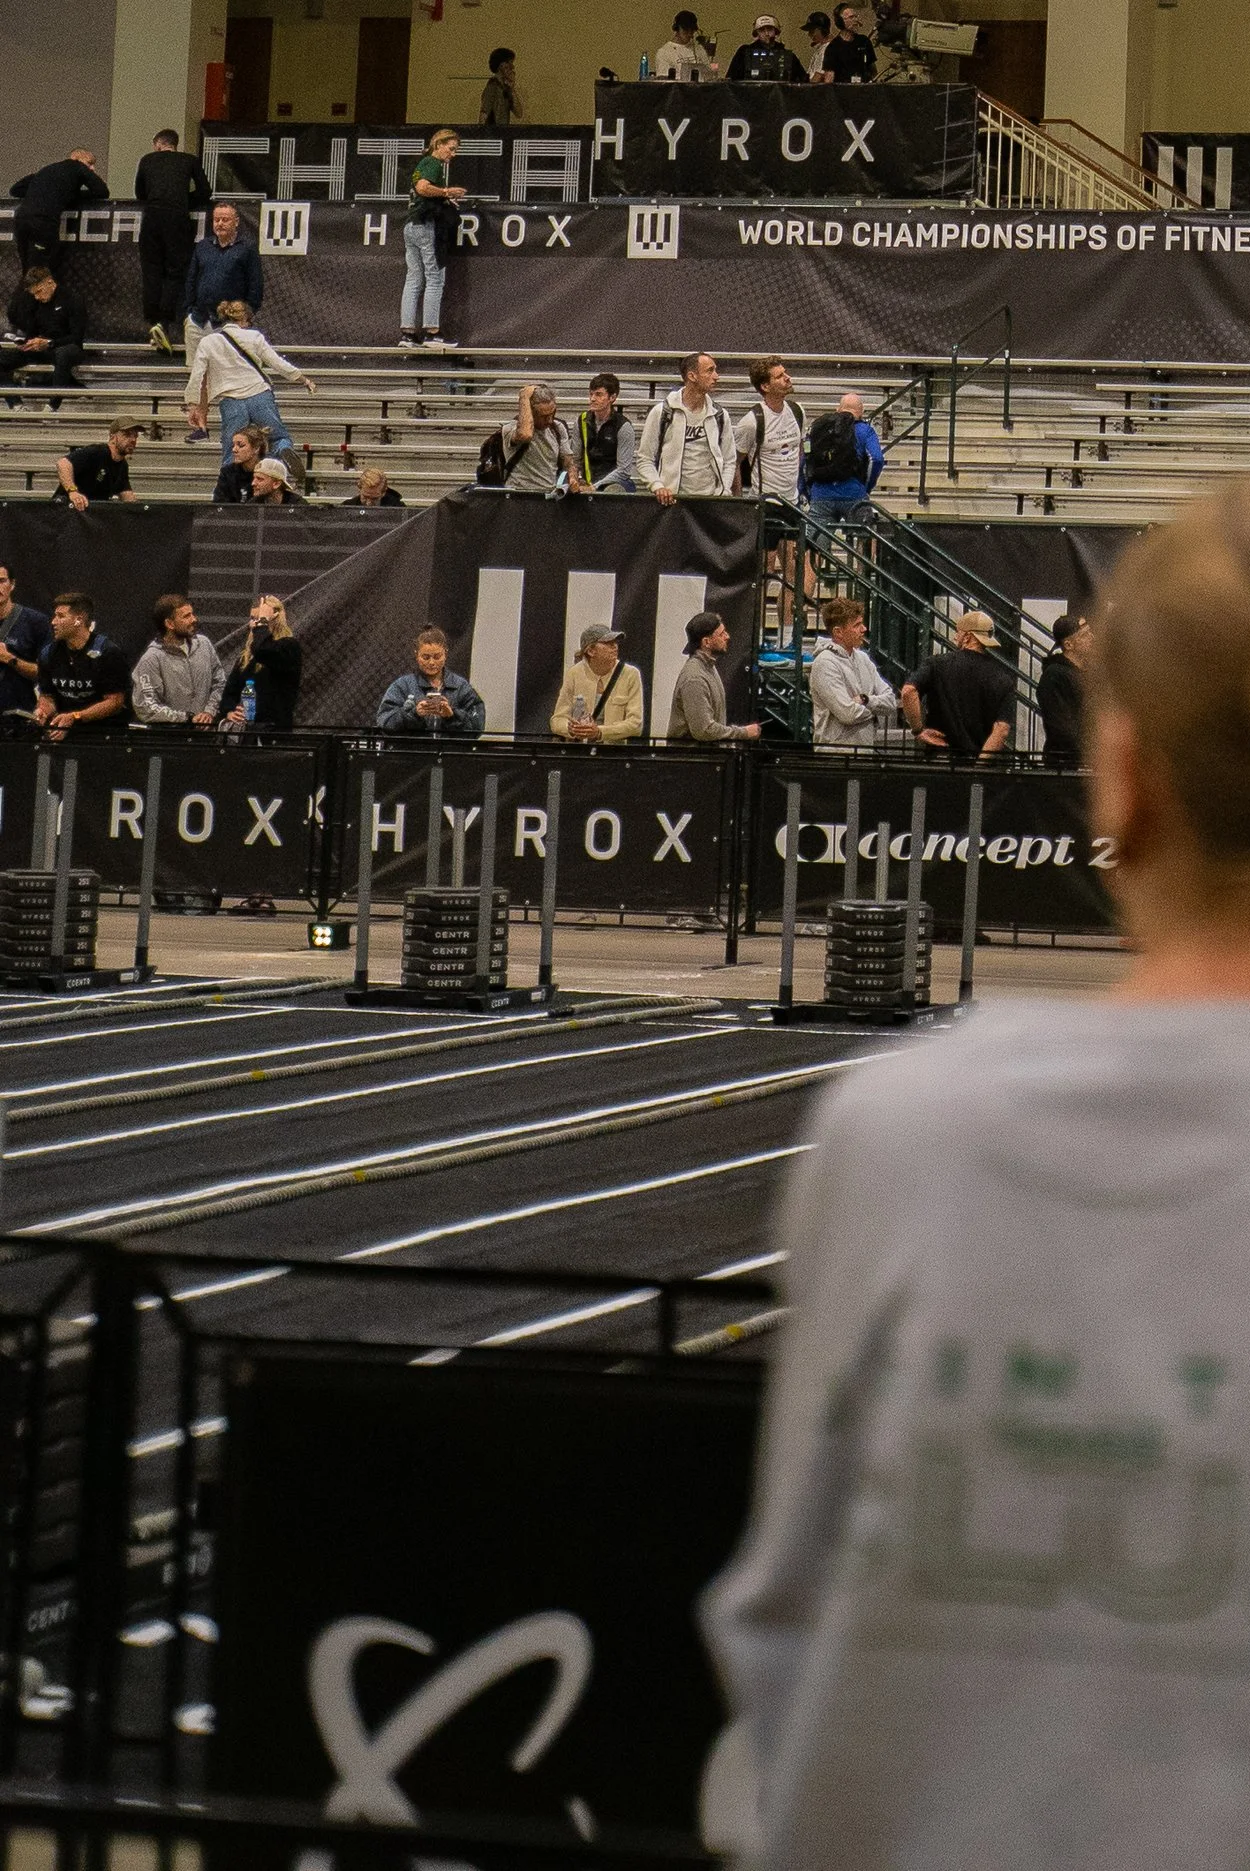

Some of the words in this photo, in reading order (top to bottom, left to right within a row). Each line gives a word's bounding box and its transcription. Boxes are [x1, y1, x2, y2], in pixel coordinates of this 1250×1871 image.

[594, 117, 875, 163] HYROX
[363, 213, 572, 247] HROX
[738, 219, 843, 247] WORLD
[852, 222, 1108, 251] CHAMPIONSHIPS
[1117, 225, 1157, 250] OF
[1088, 836, 1121, 870] 2
[434, 931, 470, 939] CENTR
[432, 947, 468, 955] CENTR
[430, 963, 464, 971] CENTR
[427, 979, 462, 987] CENTR
